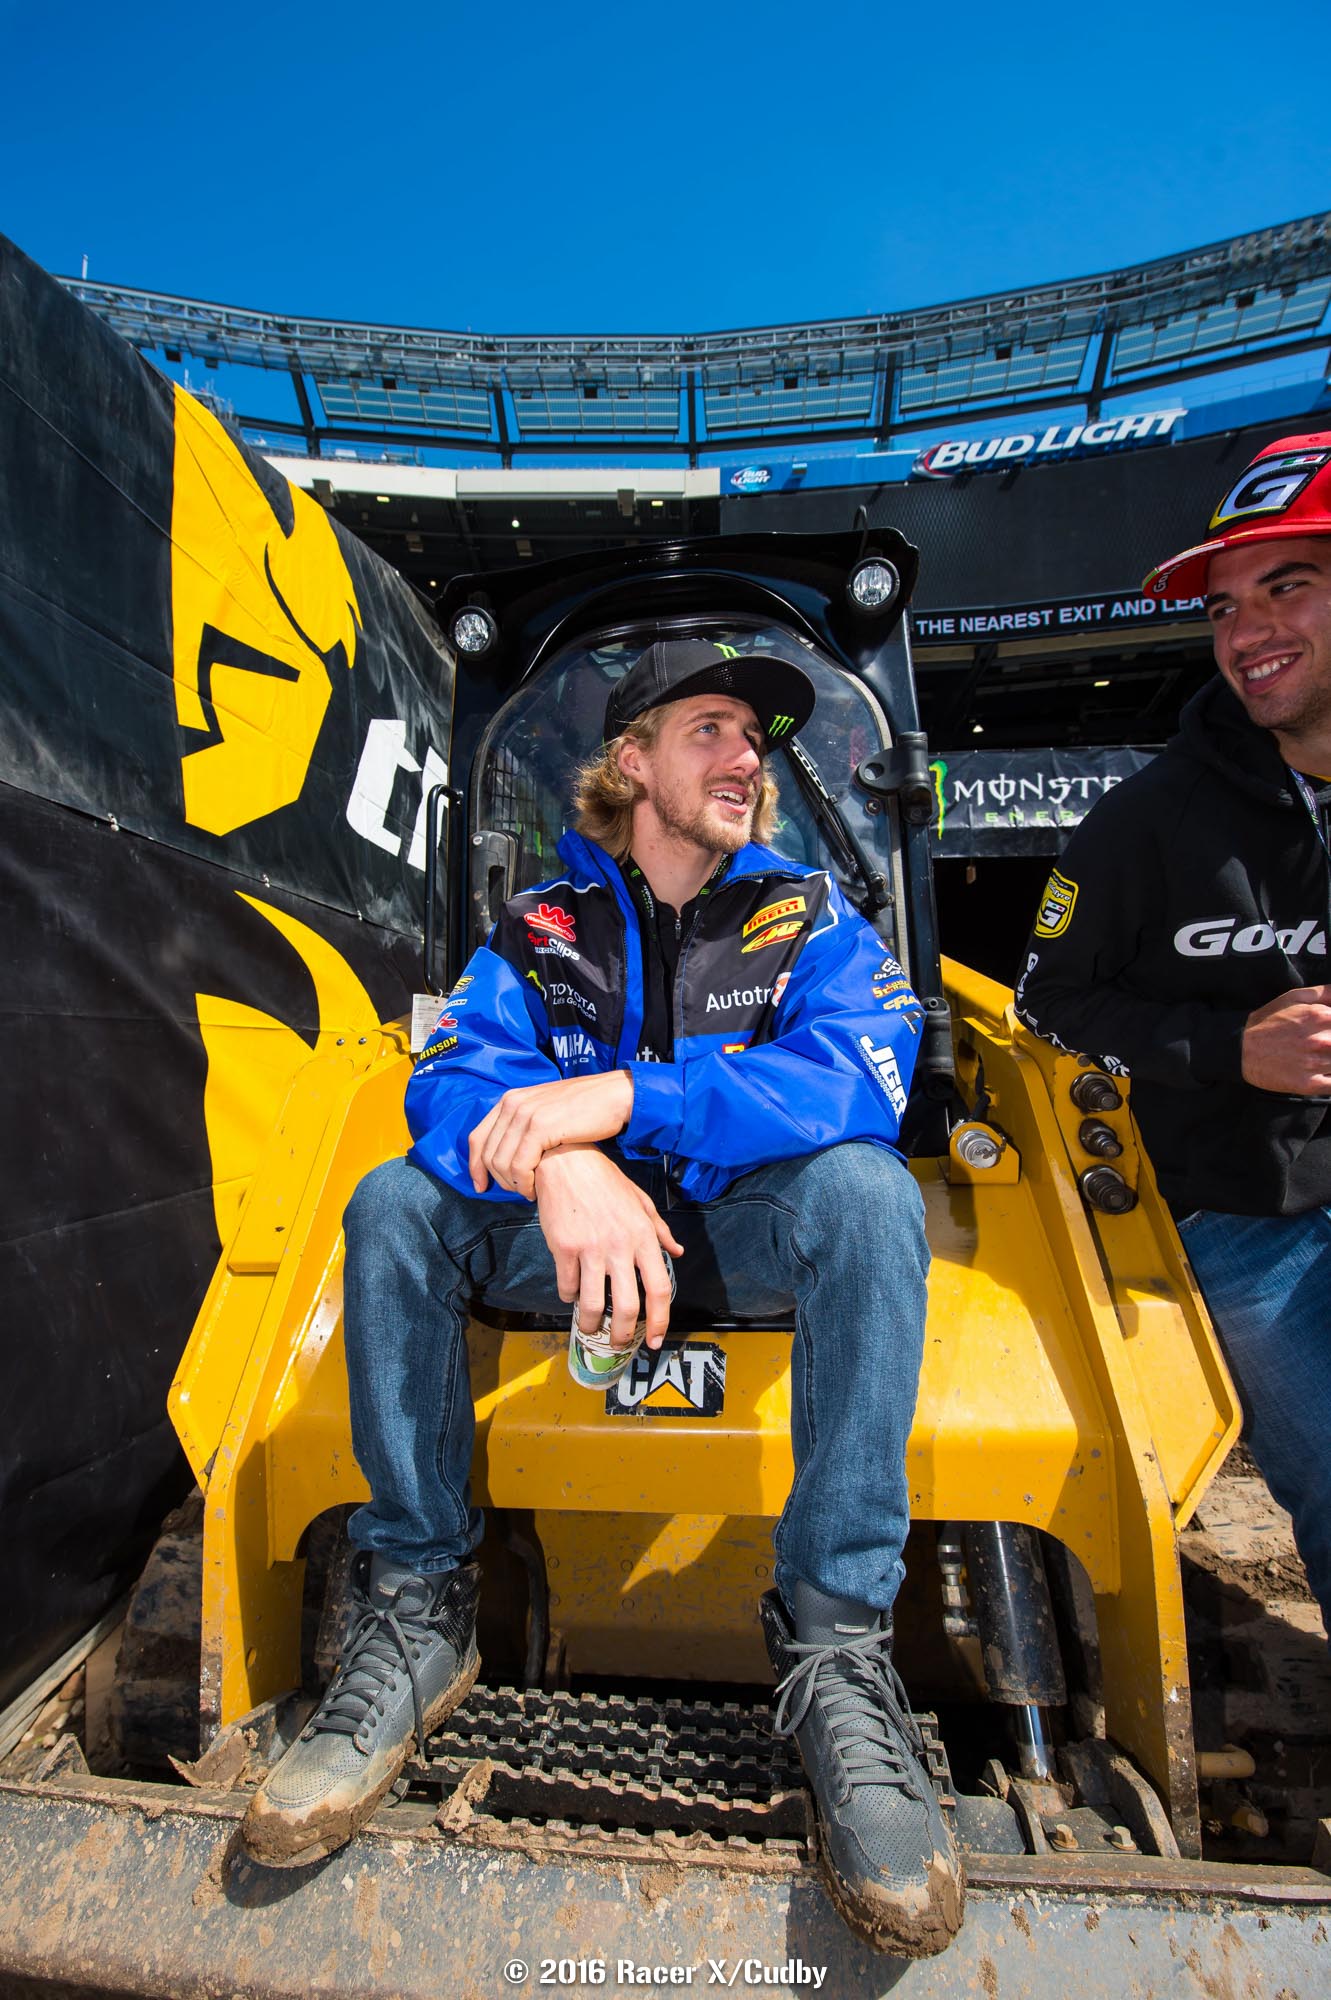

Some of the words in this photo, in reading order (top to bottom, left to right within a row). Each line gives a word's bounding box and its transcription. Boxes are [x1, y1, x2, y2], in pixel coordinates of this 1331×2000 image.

[929, 434, 1034, 470] BUD
[1036, 408, 1188, 452] LIGHT
[735, 475, 771, 484] LIGHT
[742, 469, 767, 478] BUD
[916, 618, 955, 636] THE
[960, 609, 1053, 633] NEAREST
[1059, 603, 1105, 625] EXIT
[1110, 598, 1156, 618] AND
[1161, 595, 1207, 613] LEA
[985, 809, 1090, 824] ENER
[746, 901, 800, 931] PIRELLI
[549, 983, 597, 1015] TOYOTA
[420, 1036, 459, 1061] HINSON
[617, 1350, 713, 1409] CAT
